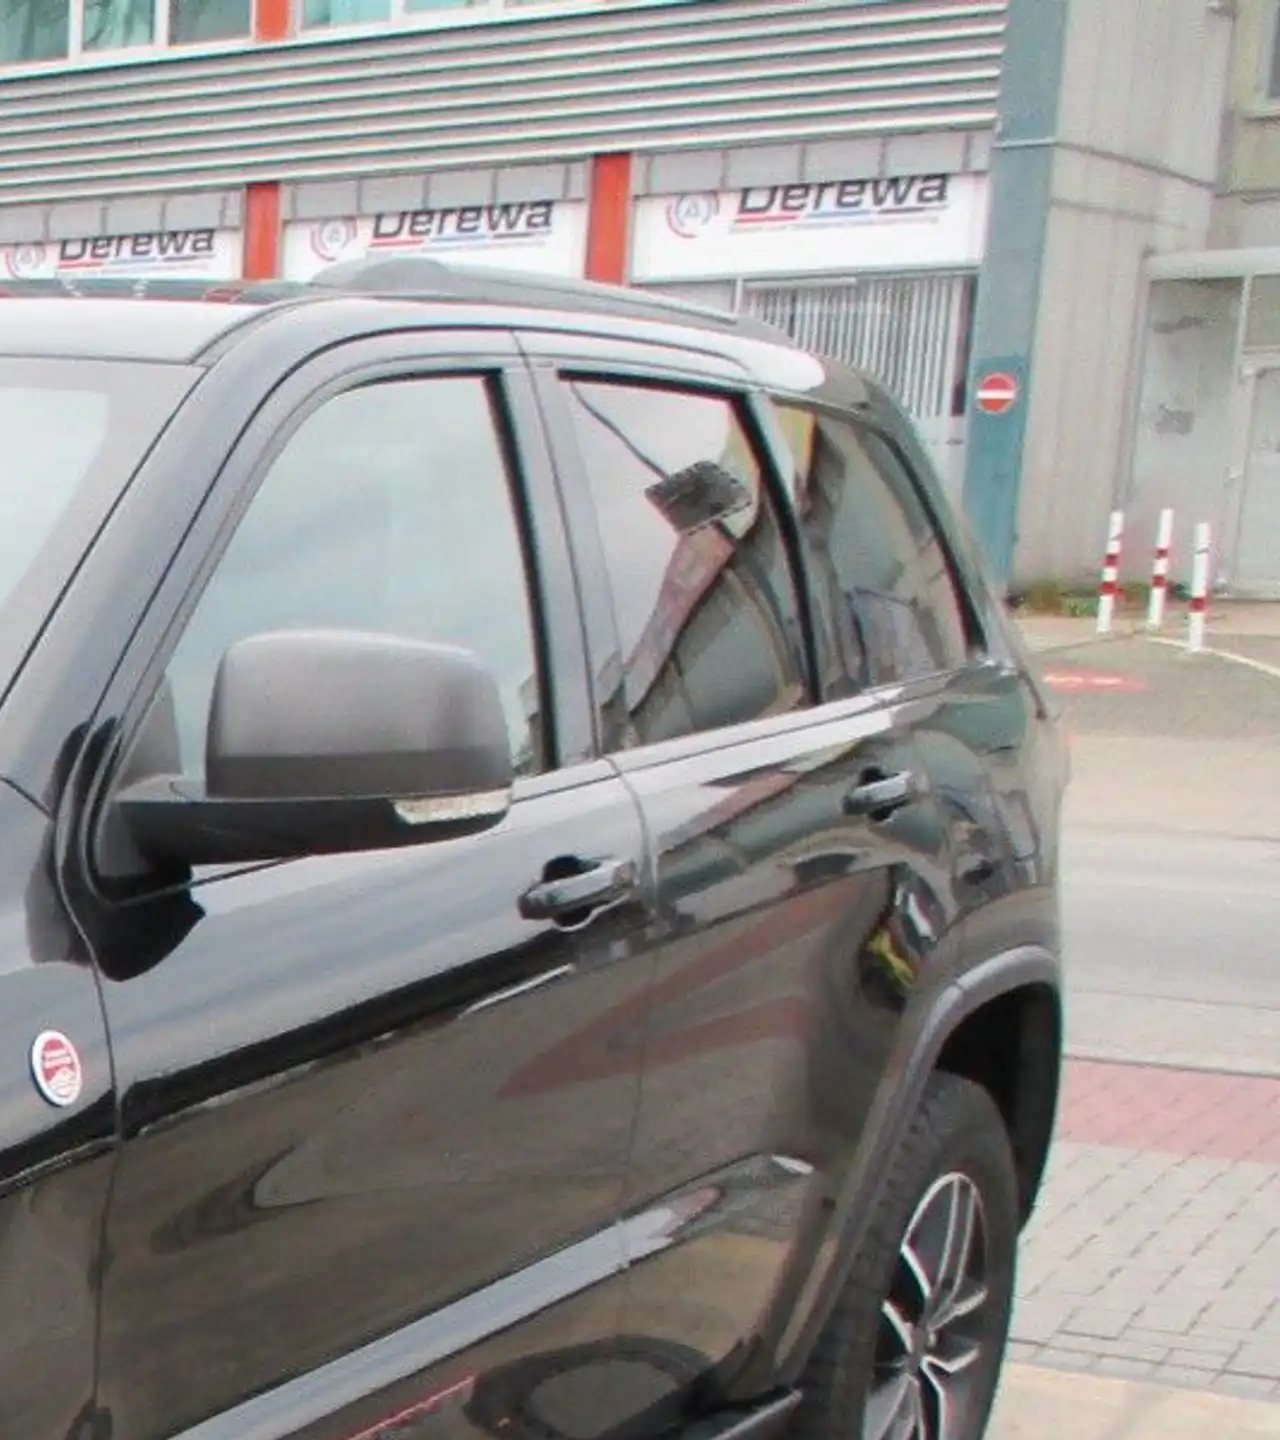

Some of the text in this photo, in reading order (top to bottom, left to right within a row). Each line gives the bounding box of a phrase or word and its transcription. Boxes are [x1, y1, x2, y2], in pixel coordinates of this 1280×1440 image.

[739, 173, 951, 214] Derewa
[372, 200, 555, 239] Derewa
[58, 229, 216, 261] Derewa
